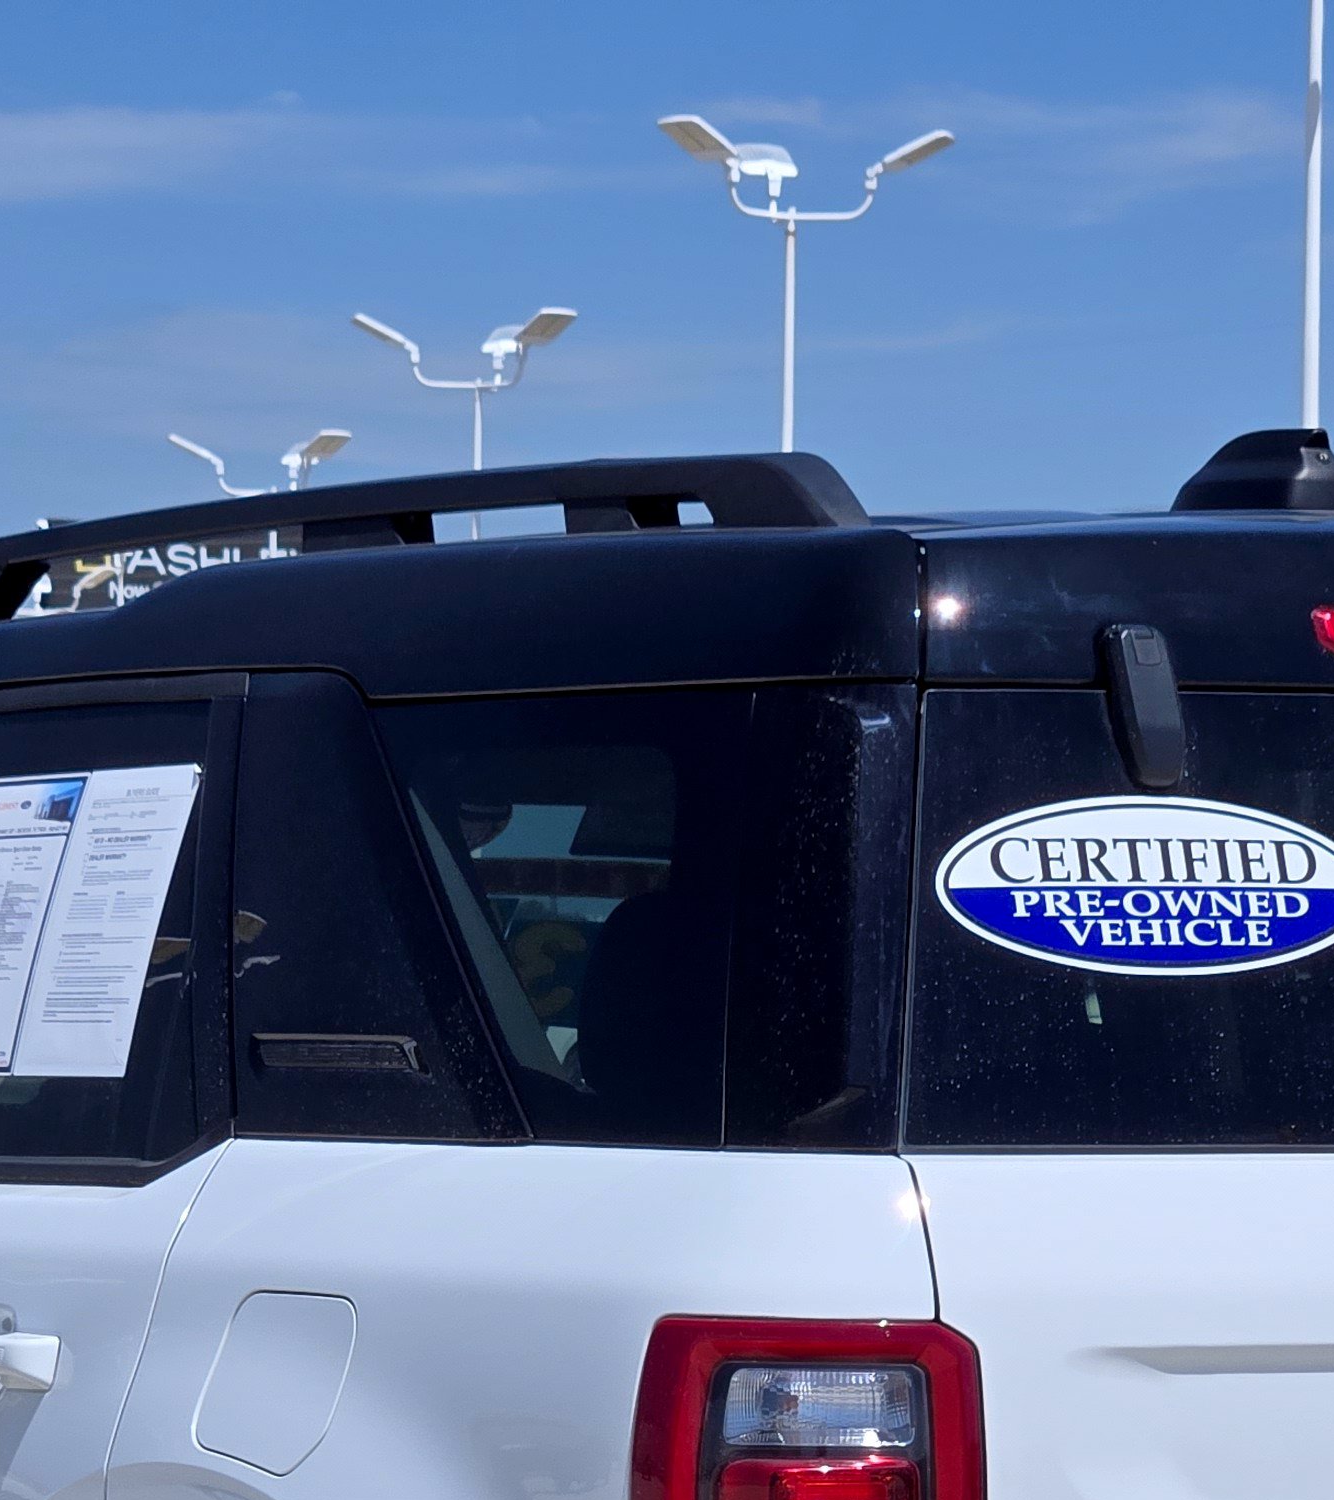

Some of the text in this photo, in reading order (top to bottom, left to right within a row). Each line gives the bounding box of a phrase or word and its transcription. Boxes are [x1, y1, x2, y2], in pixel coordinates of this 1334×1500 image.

[989, 836, 1318, 886] CERTIFIED
[1009, 888, 1310, 919] PRE-OWNED
[1058, 918, 1274, 947] VEHICLE
